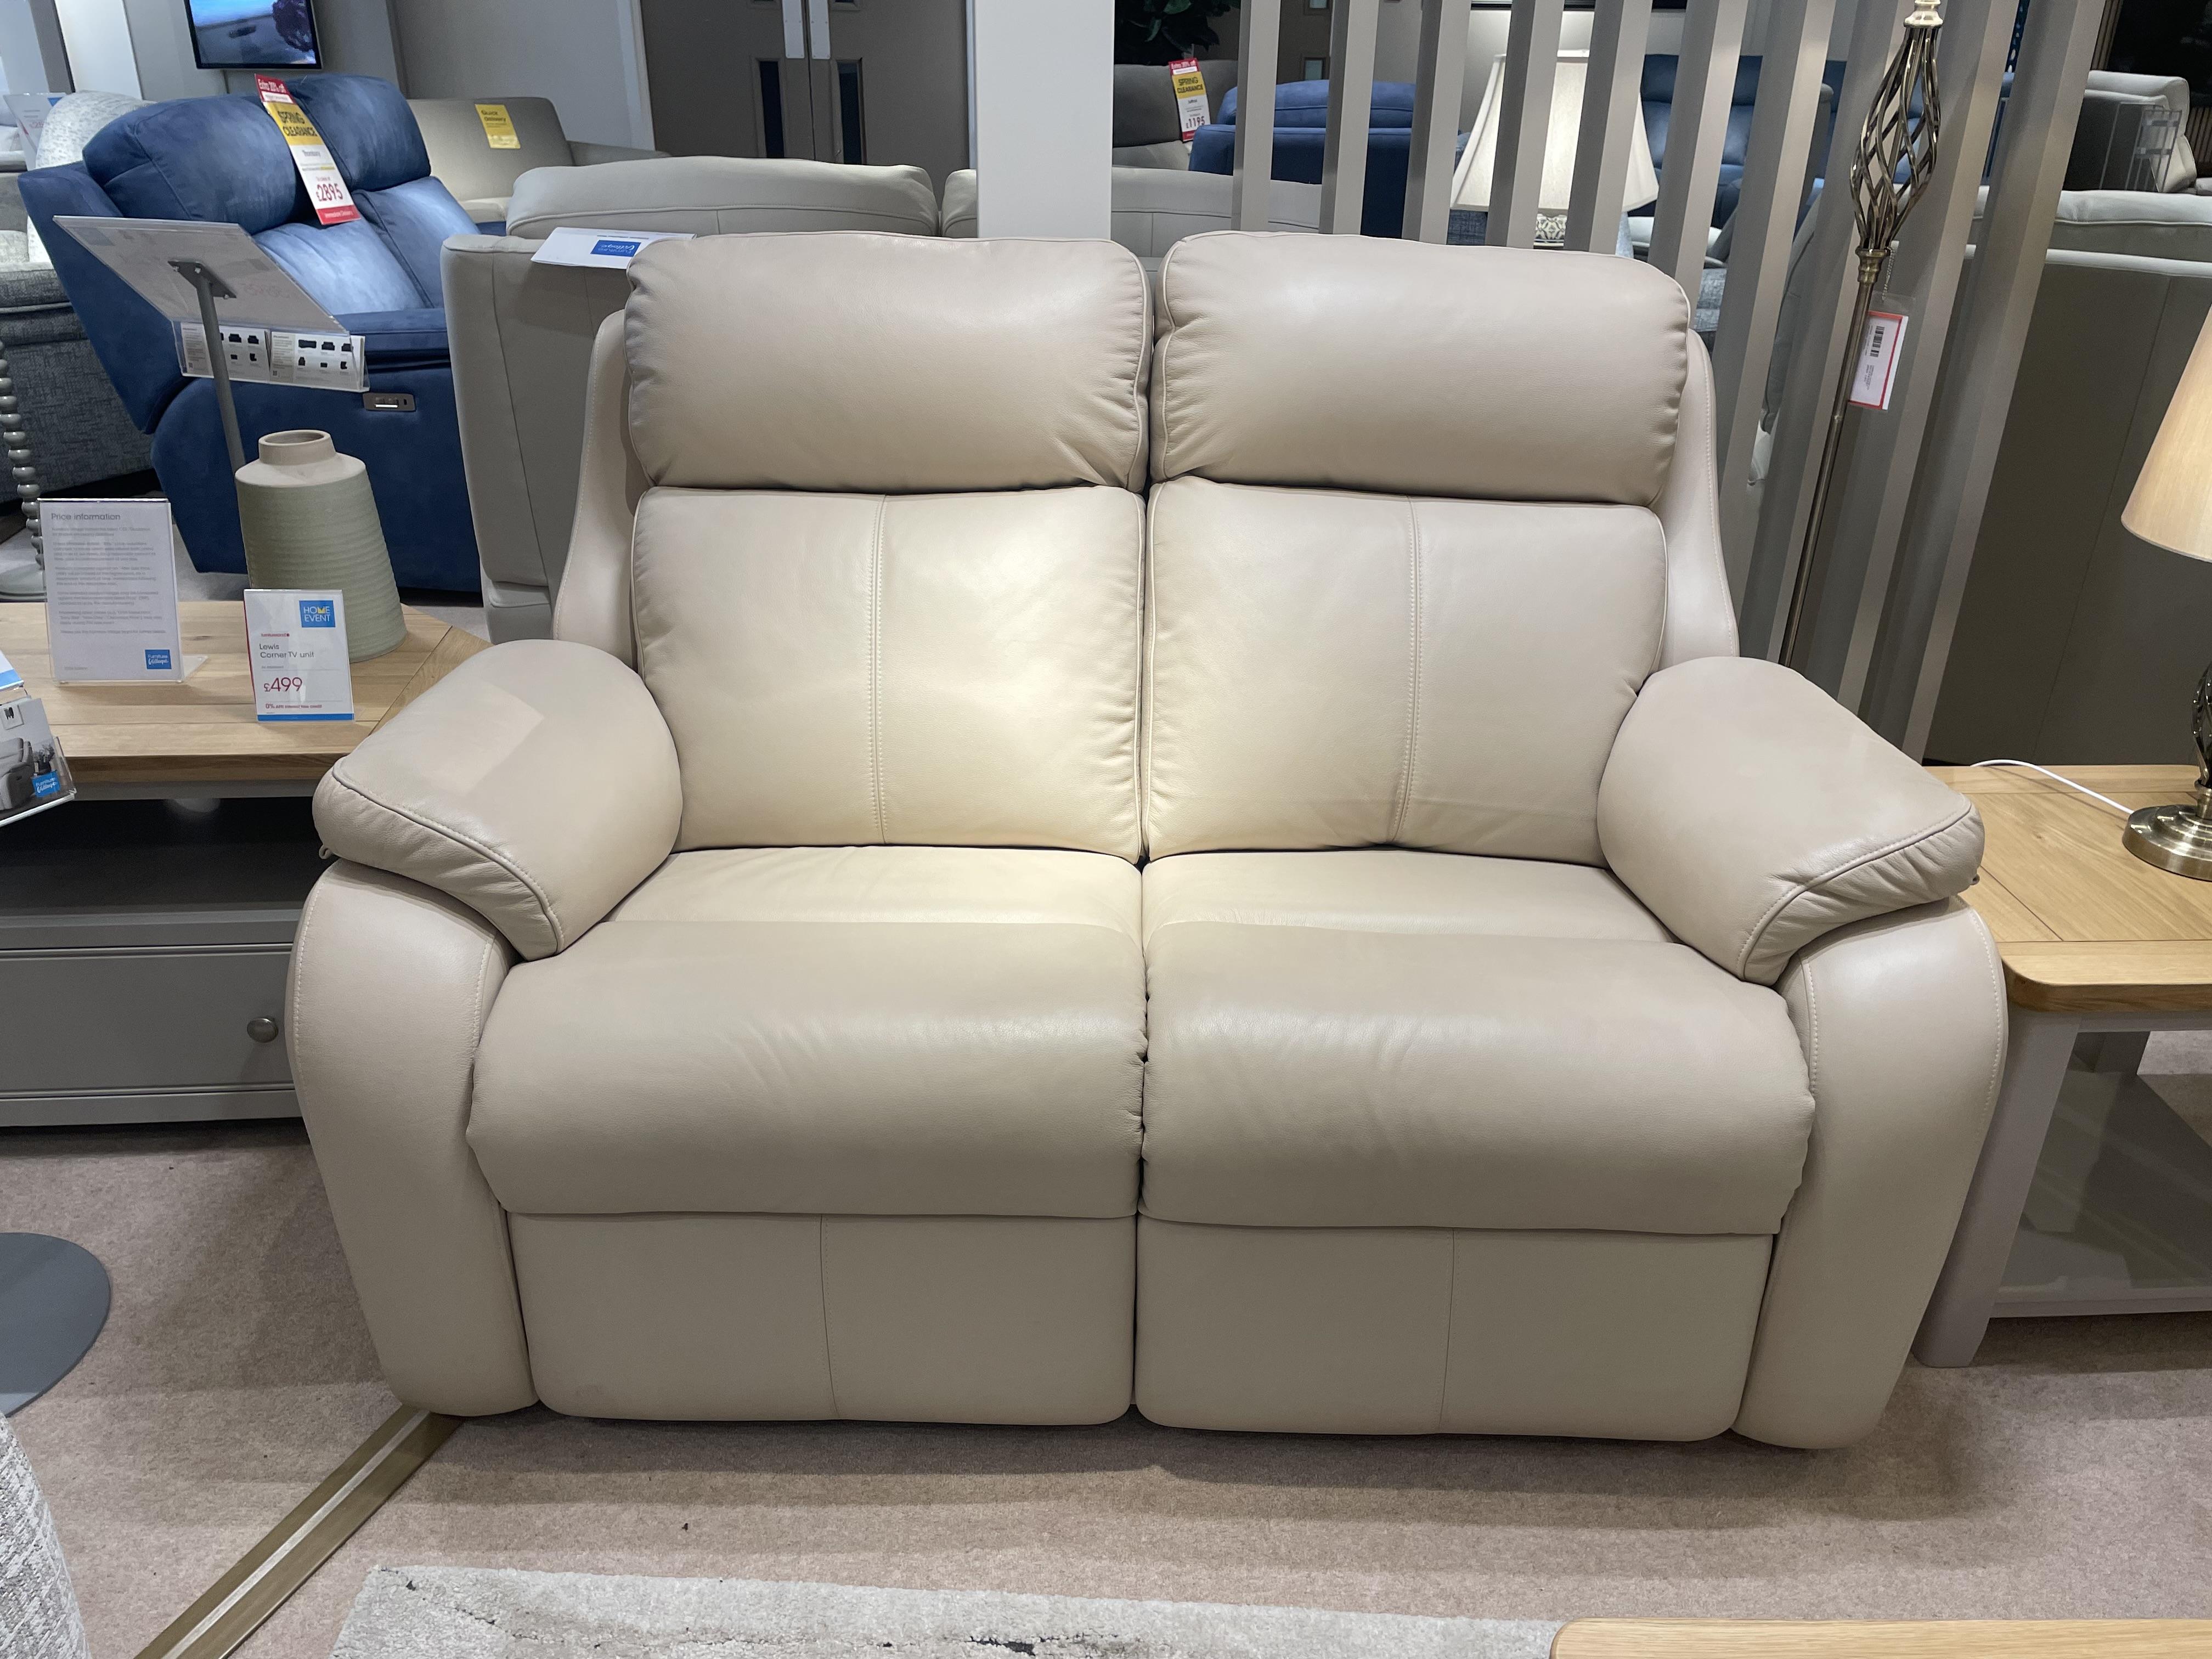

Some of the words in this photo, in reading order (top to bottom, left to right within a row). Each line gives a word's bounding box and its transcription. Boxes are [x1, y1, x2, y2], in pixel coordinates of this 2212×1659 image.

[1178, 77, 1199, 86] SPRING
[1177, 84, 1203, 93] CLEARANCE
[278, 111, 305, 124] SPRING
[283, 126, 318, 136] CLEARANCE
[316, 183, 343, 202] £2895
[304, 614, 330, 622] EVENT
[264, 677, 303, 692] £499
[37, 781, 58, 793] Village
